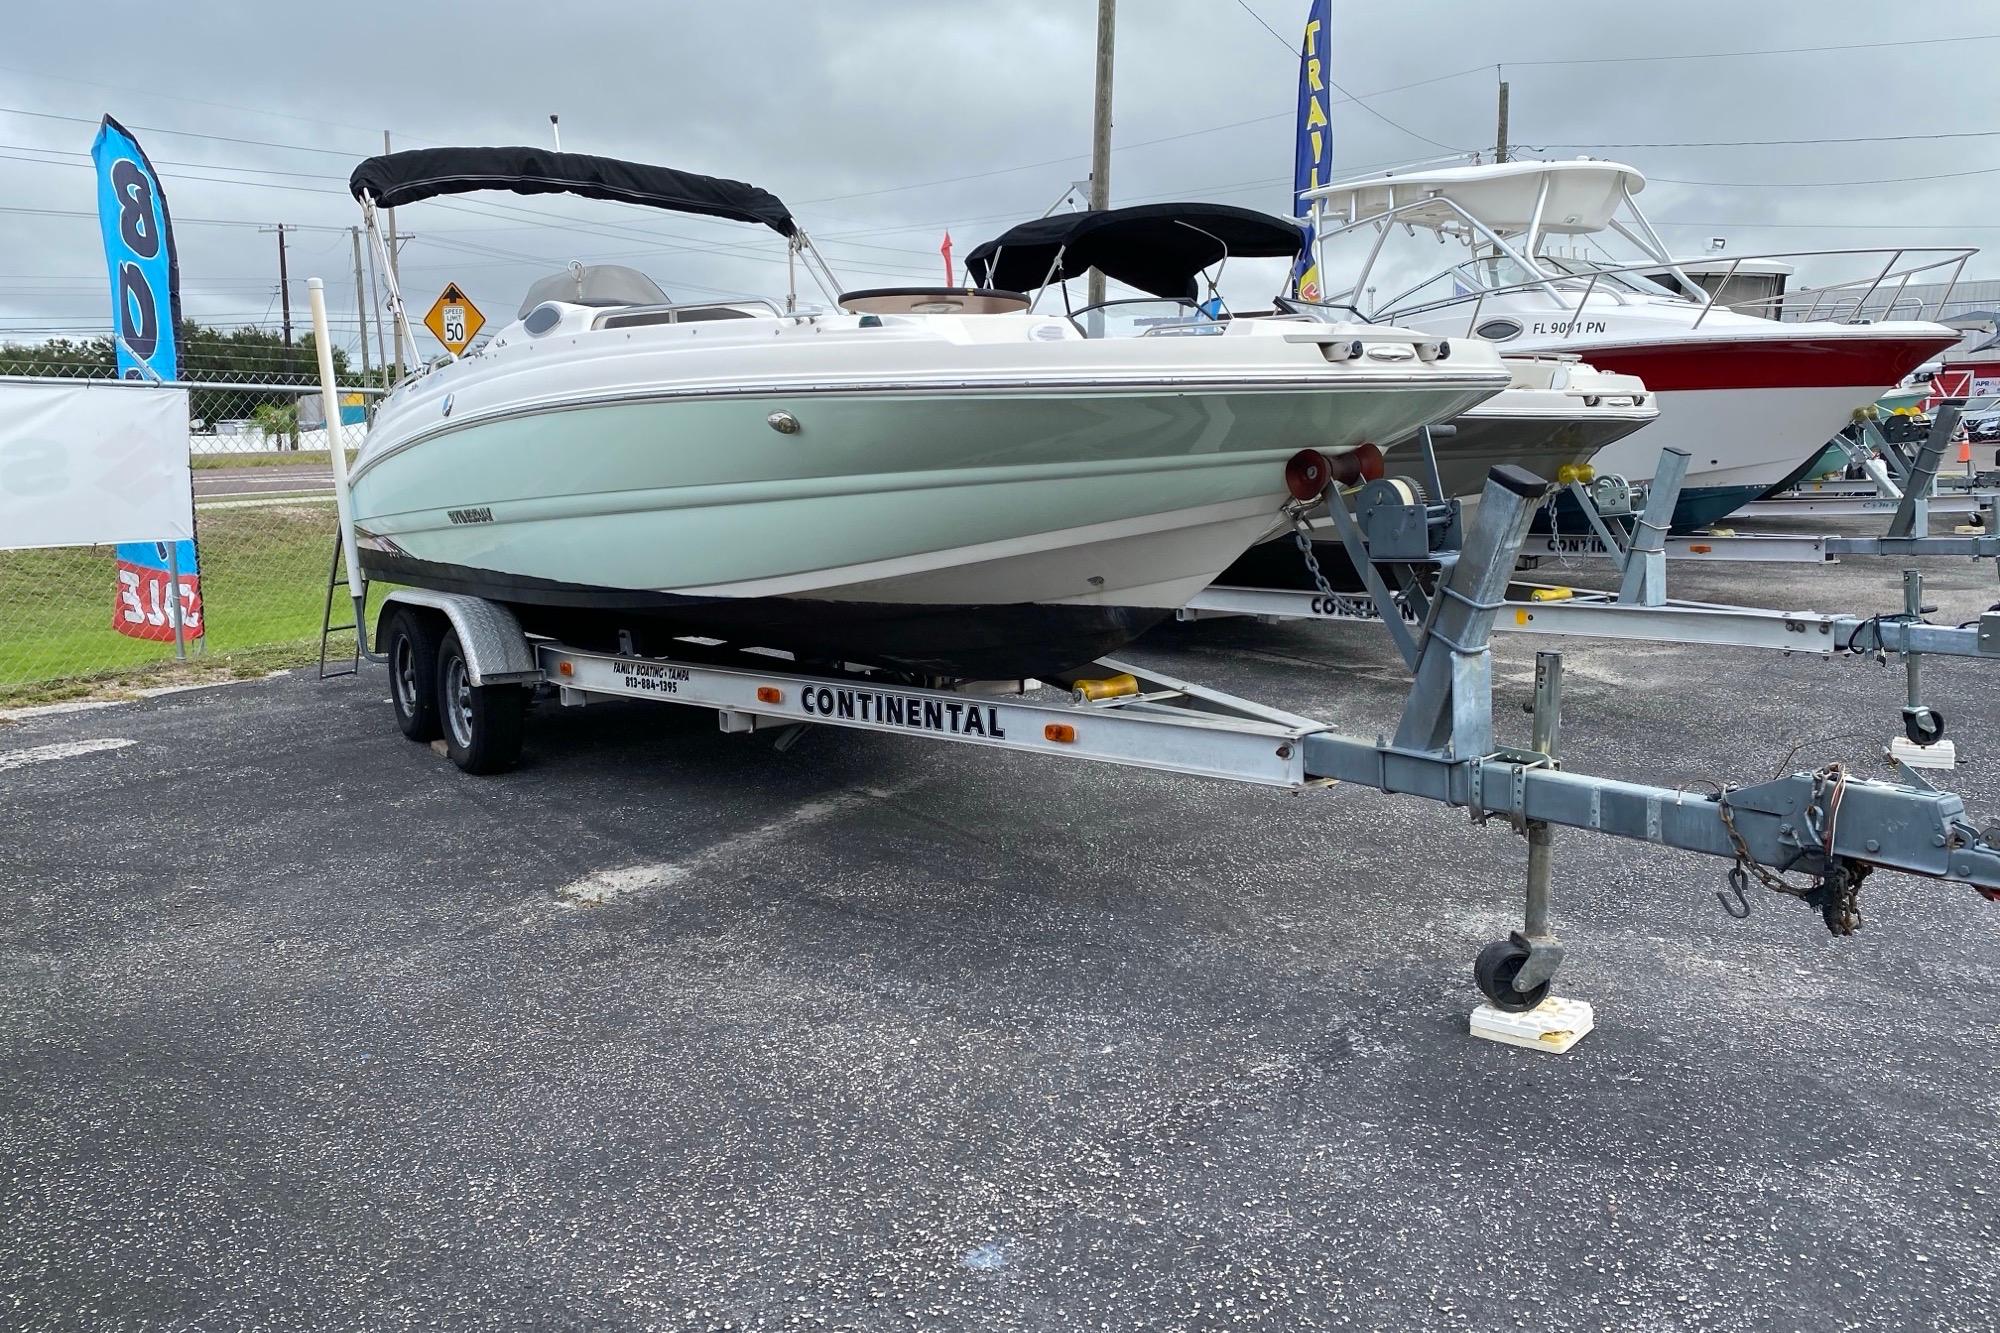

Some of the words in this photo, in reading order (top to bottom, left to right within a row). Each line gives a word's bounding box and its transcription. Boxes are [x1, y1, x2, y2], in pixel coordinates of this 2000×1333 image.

[446, 322, 464, 341] 50
[1533, 322, 1547, 334] FL
[1586, 321, 1606, 334] PN
[613, 661, 636, 675] FAMILY
[636, 664, 664, 679] BOATING
[668, 668, 690, 681] TAMPA
[625, 676, 678, 693] 813-884-1395
[801, 684, 1006, 740] CONTINENTAL
